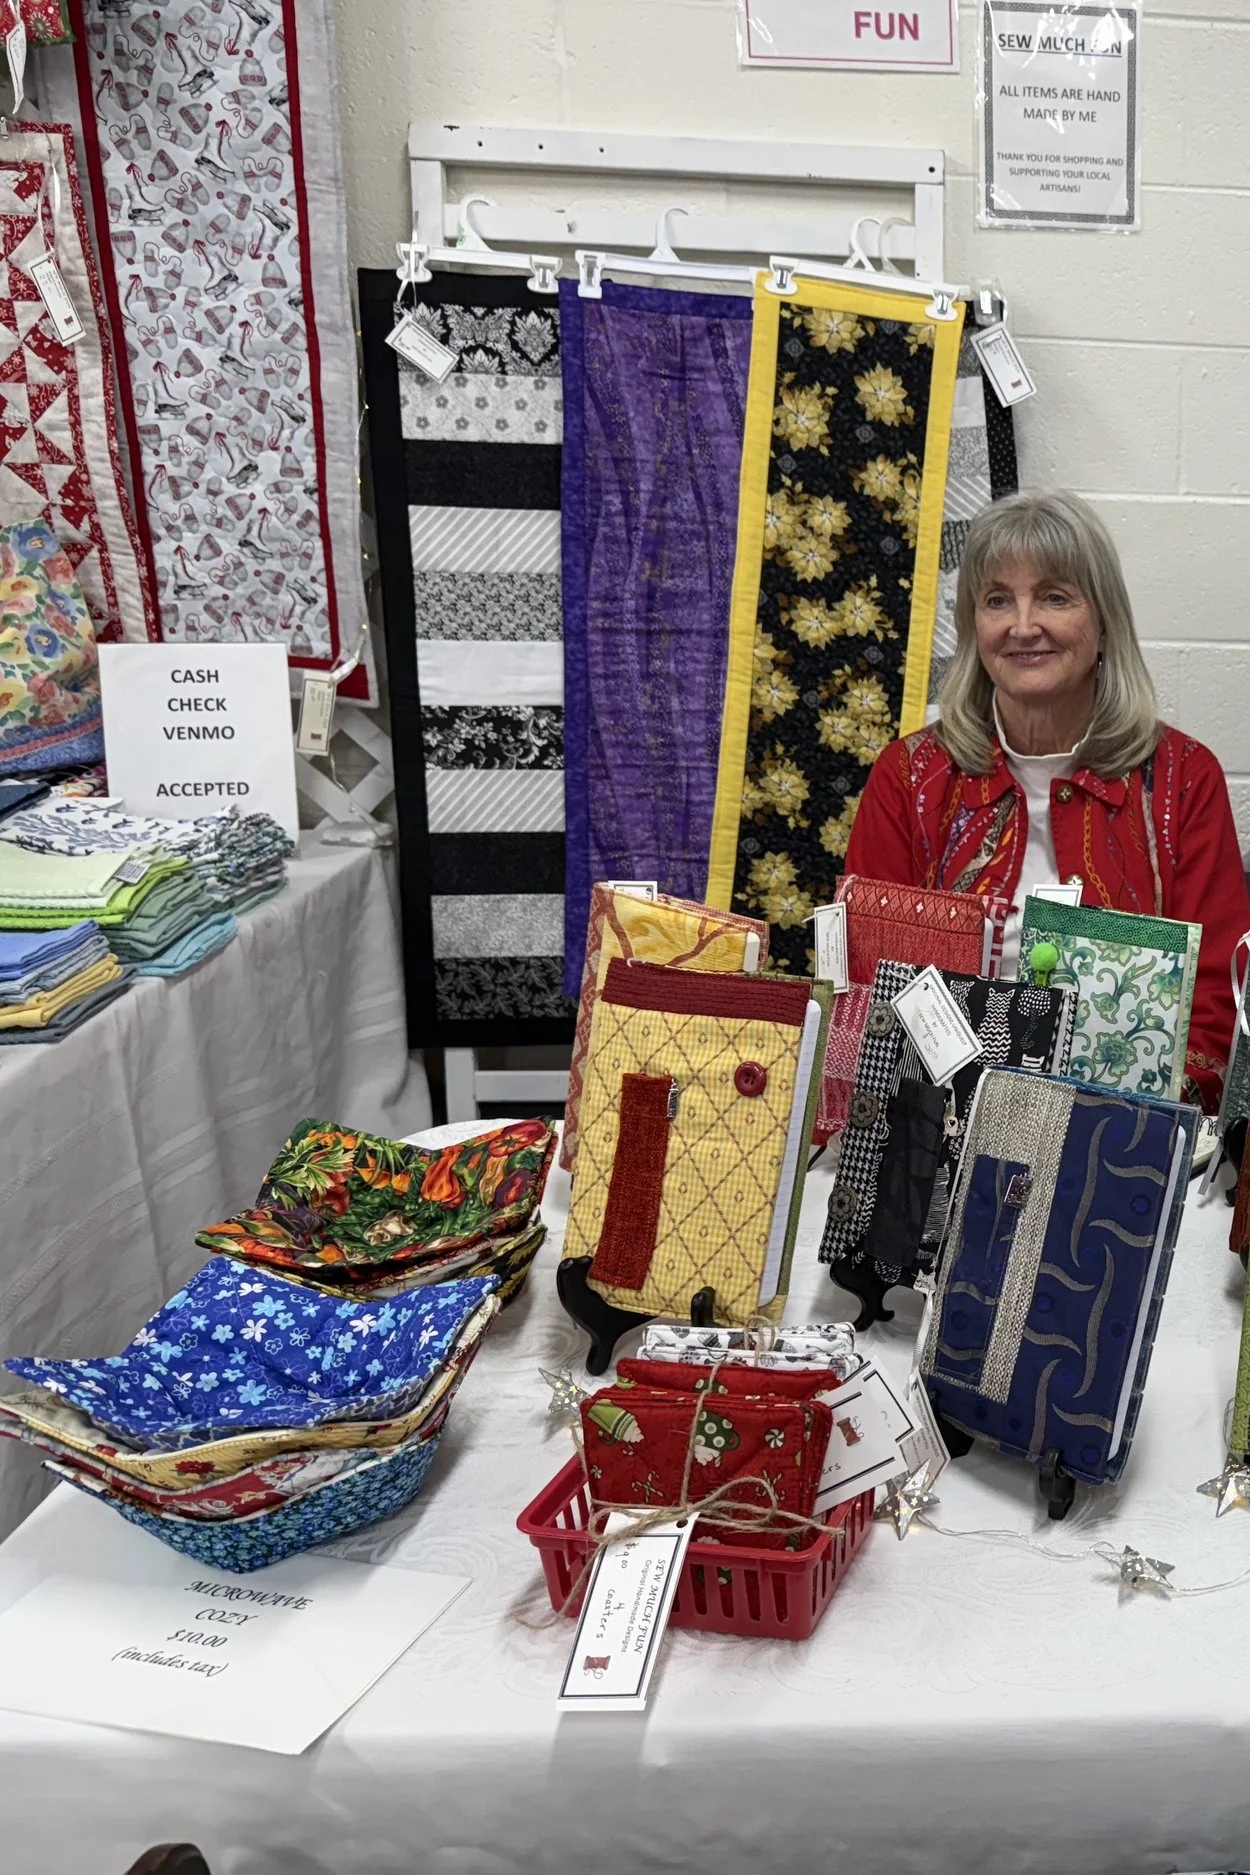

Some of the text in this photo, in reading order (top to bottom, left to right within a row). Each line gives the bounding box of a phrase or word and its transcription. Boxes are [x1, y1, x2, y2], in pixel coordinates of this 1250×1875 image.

[854, 11, 919, 41] FUN
[999, 34, 1032, 48] SEW
[1038, 36, 1085, 51] MUCH
[999, 85, 1121, 102] ALL ITEMS ARE HAND
[1024, 108, 1097, 122] MADE BY ME
[997, 152, 1123, 166] THANK YOU FOR SHOPPING AND
[1009, 168, 1060, 177] SUPPORTING
[1086, 172, 1111, 180] LOCAL
[1040, 184, 1081, 192] ARTISANS!
[171, 669, 219, 683] CASH
[168, 698, 227, 712] CHECK
[163, 726, 235, 740] VENMO
[156, 782, 249, 797] ACCEPTED
[184, 1580, 314, 1611] MICROWAVE
[621, 1559, 653, 1653] Original Handmade Designs
[634, 1559, 666, 1655] SEW MUCH FUN
[195, 1608, 259, 1626] COZY
[166, 1629, 228, 1648] $10.00
[111, 1646, 229, 1677] (includes tax)
